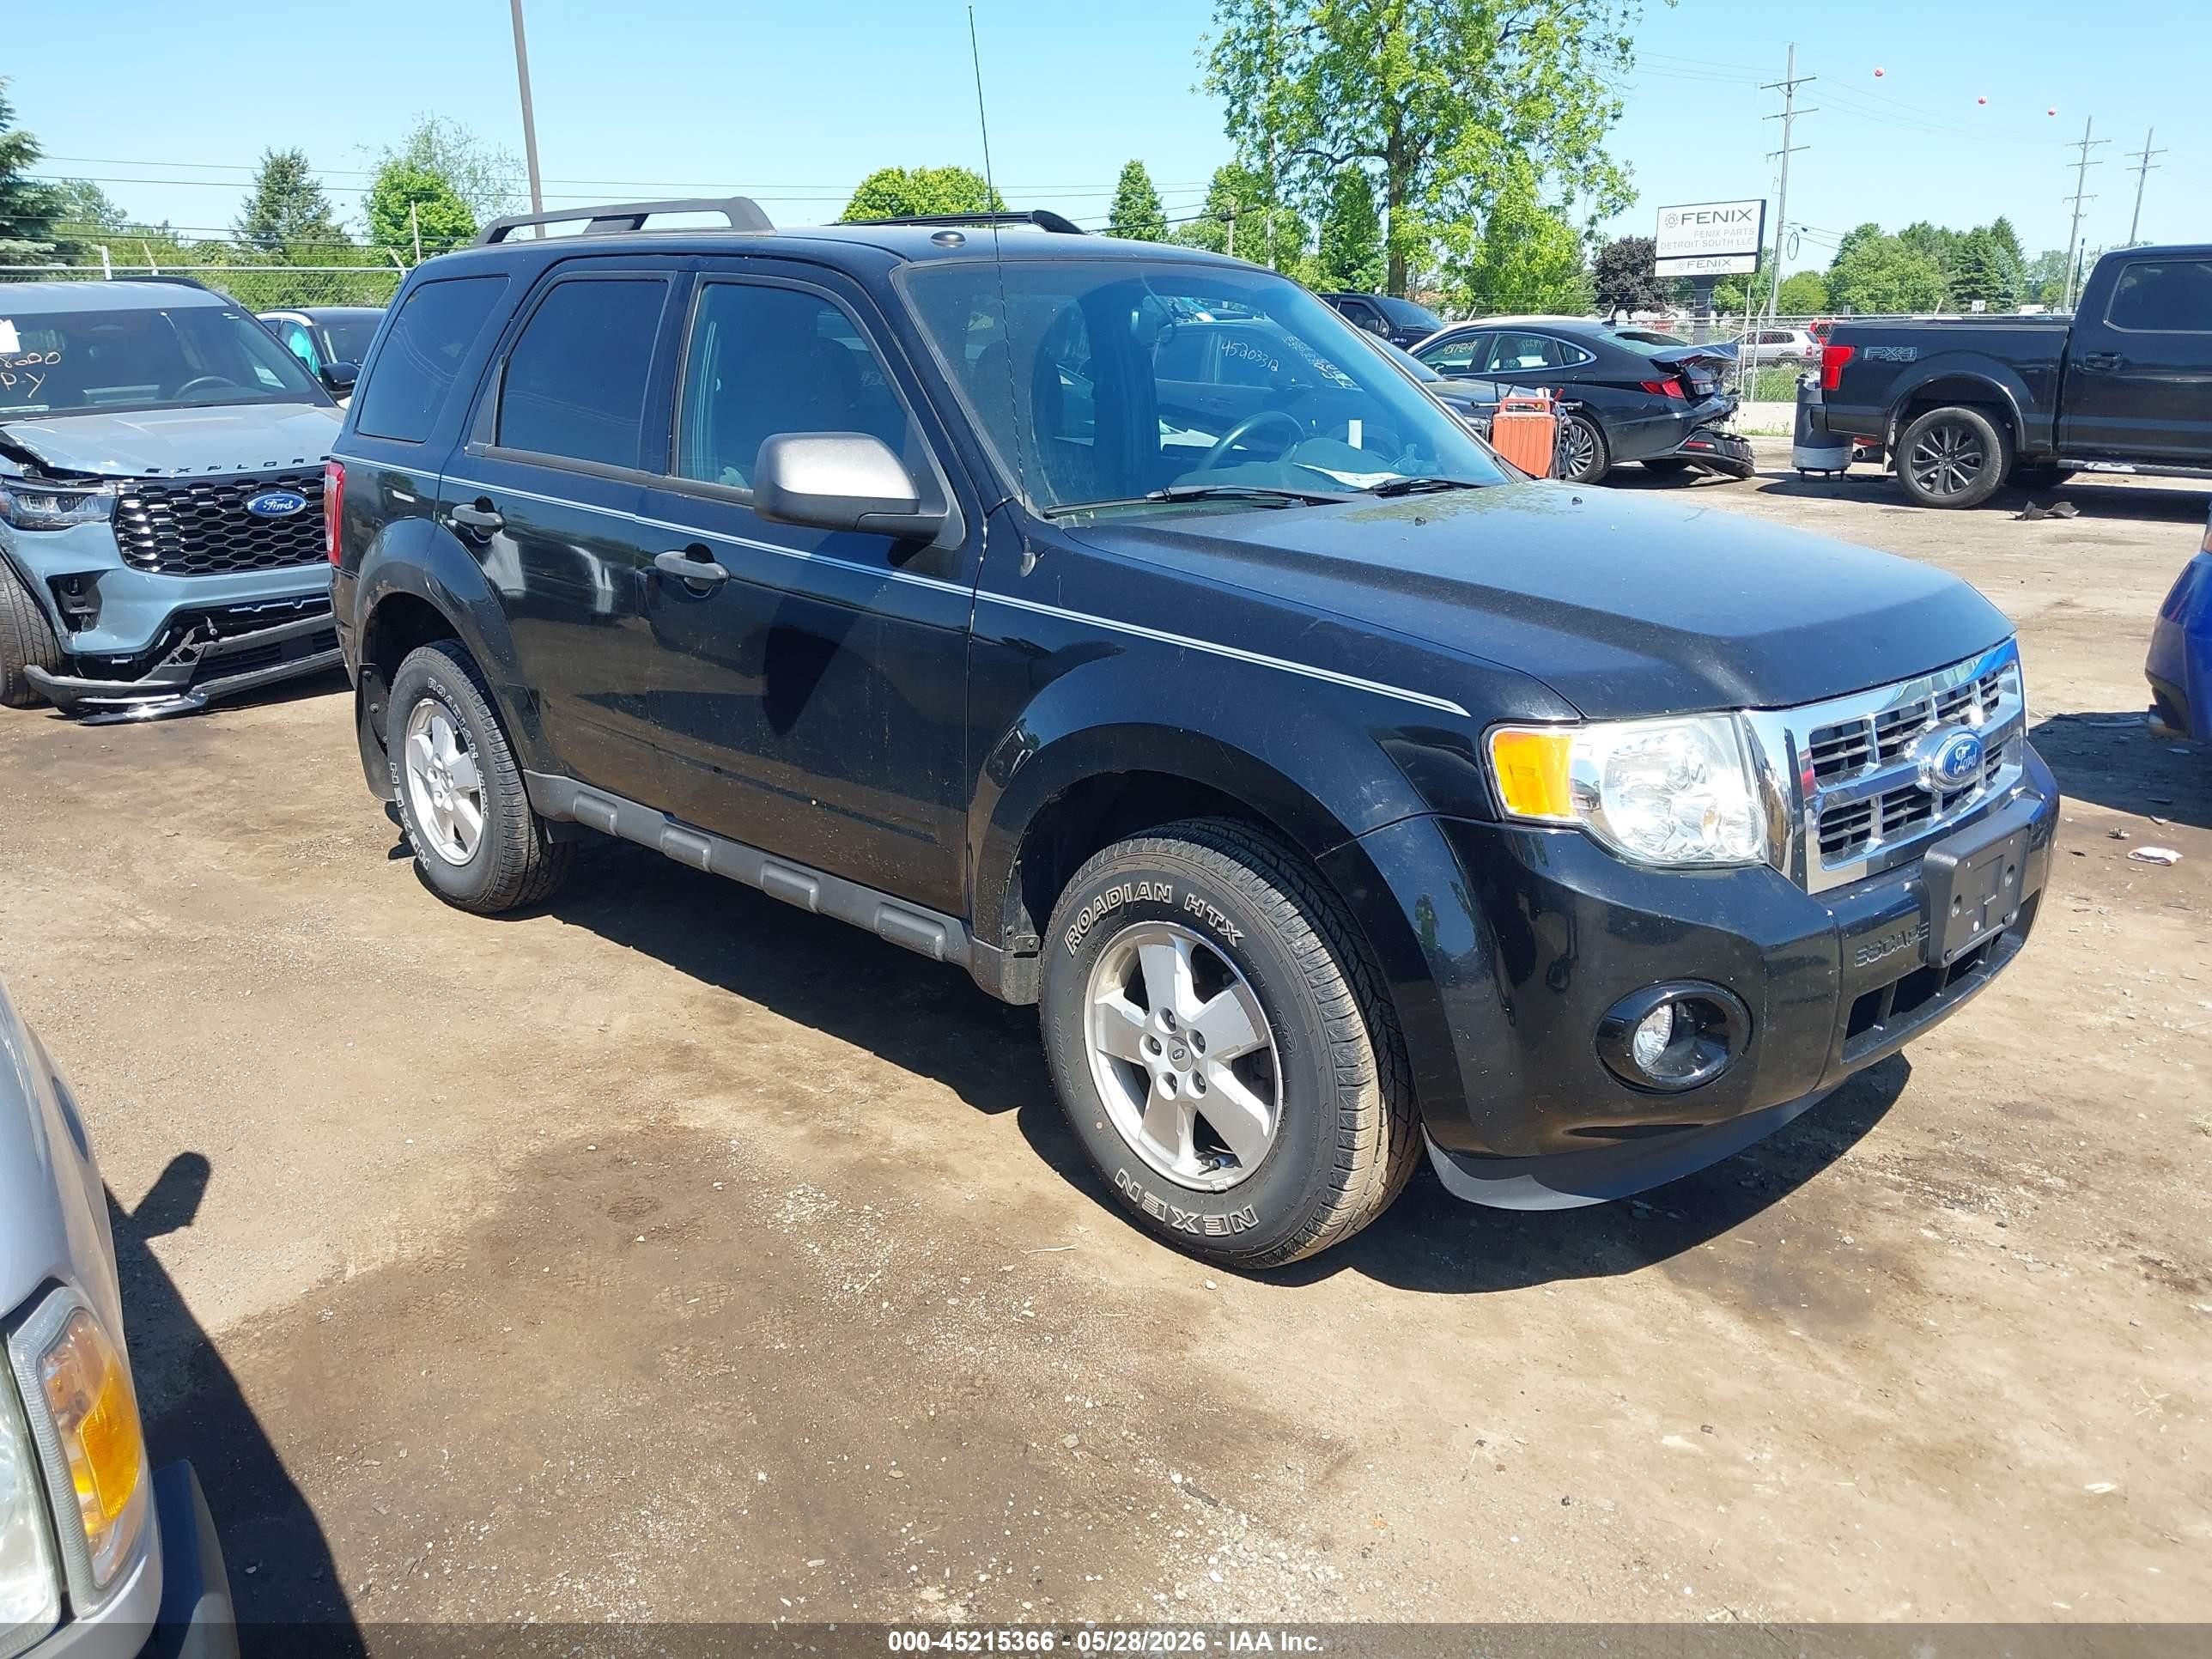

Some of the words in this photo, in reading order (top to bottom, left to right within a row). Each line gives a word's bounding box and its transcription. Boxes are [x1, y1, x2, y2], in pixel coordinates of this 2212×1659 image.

[1680, 209, 1753, 225] FENIX
[1660, 240, 1700, 251] DETROIT
[1702, 238, 1734, 248] SOUTH
[1736, 237, 1754, 246] LLC
[1693, 230, 1721, 240] FENIX
[1723, 228, 1755, 237] PARTS
[1686, 258, 1732, 269] FENIX
[1221, 340, 1279, 372] 45203312
[1863, 346, 1917, 361] FX4
[263, 498, 294, 510] Ford
[428, 678, 478, 760] ROADIAN
[1954, 744, 1978, 775] Ford
[1064, 881, 1173, 958] ROADIAN
[1184, 891, 1246, 948] HTX
[1855, 921, 1929, 968] ESCAPE
[1114, 1167, 1261, 1237] NEXEN
